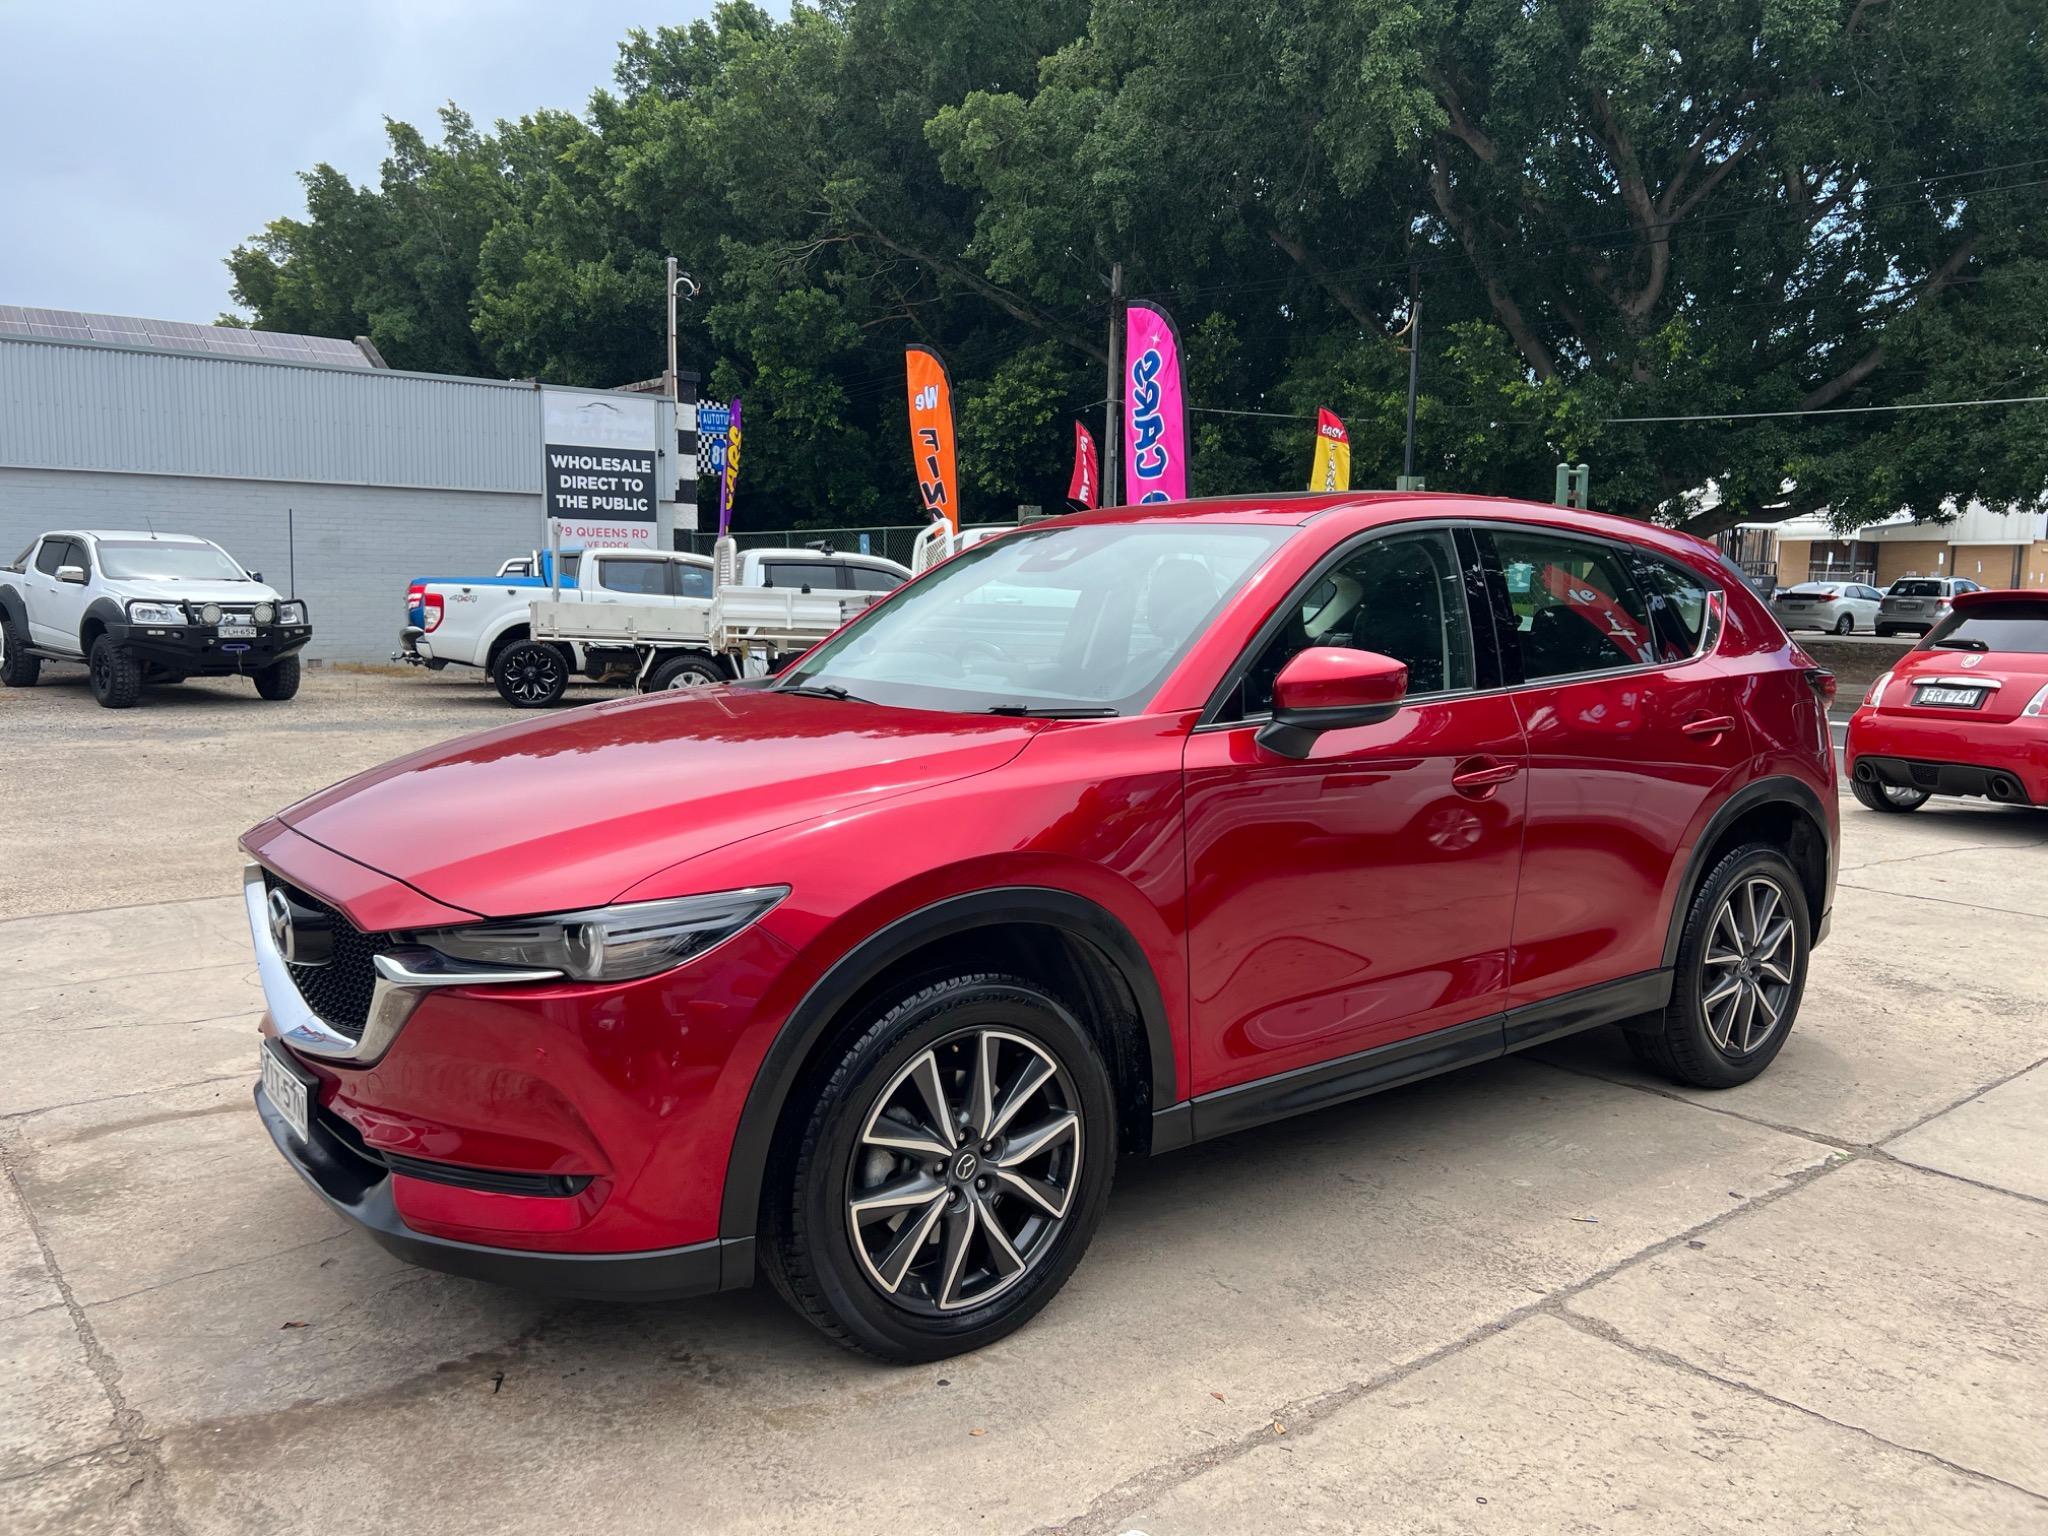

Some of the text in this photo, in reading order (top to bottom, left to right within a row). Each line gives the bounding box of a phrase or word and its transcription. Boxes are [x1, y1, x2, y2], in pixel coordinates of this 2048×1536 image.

[1322, 424, 1344, 439] EASY
[551, 454, 651, 473] WHOLESALE
[560, 475, 644, 493] DIRECT TO
[556, 495, 648, 511] THE PUBLIC
[576, 526, 628, 538] QUEENS
[632, 529, 648, 539] RD
[602, 541, 629, 549] DOCK
